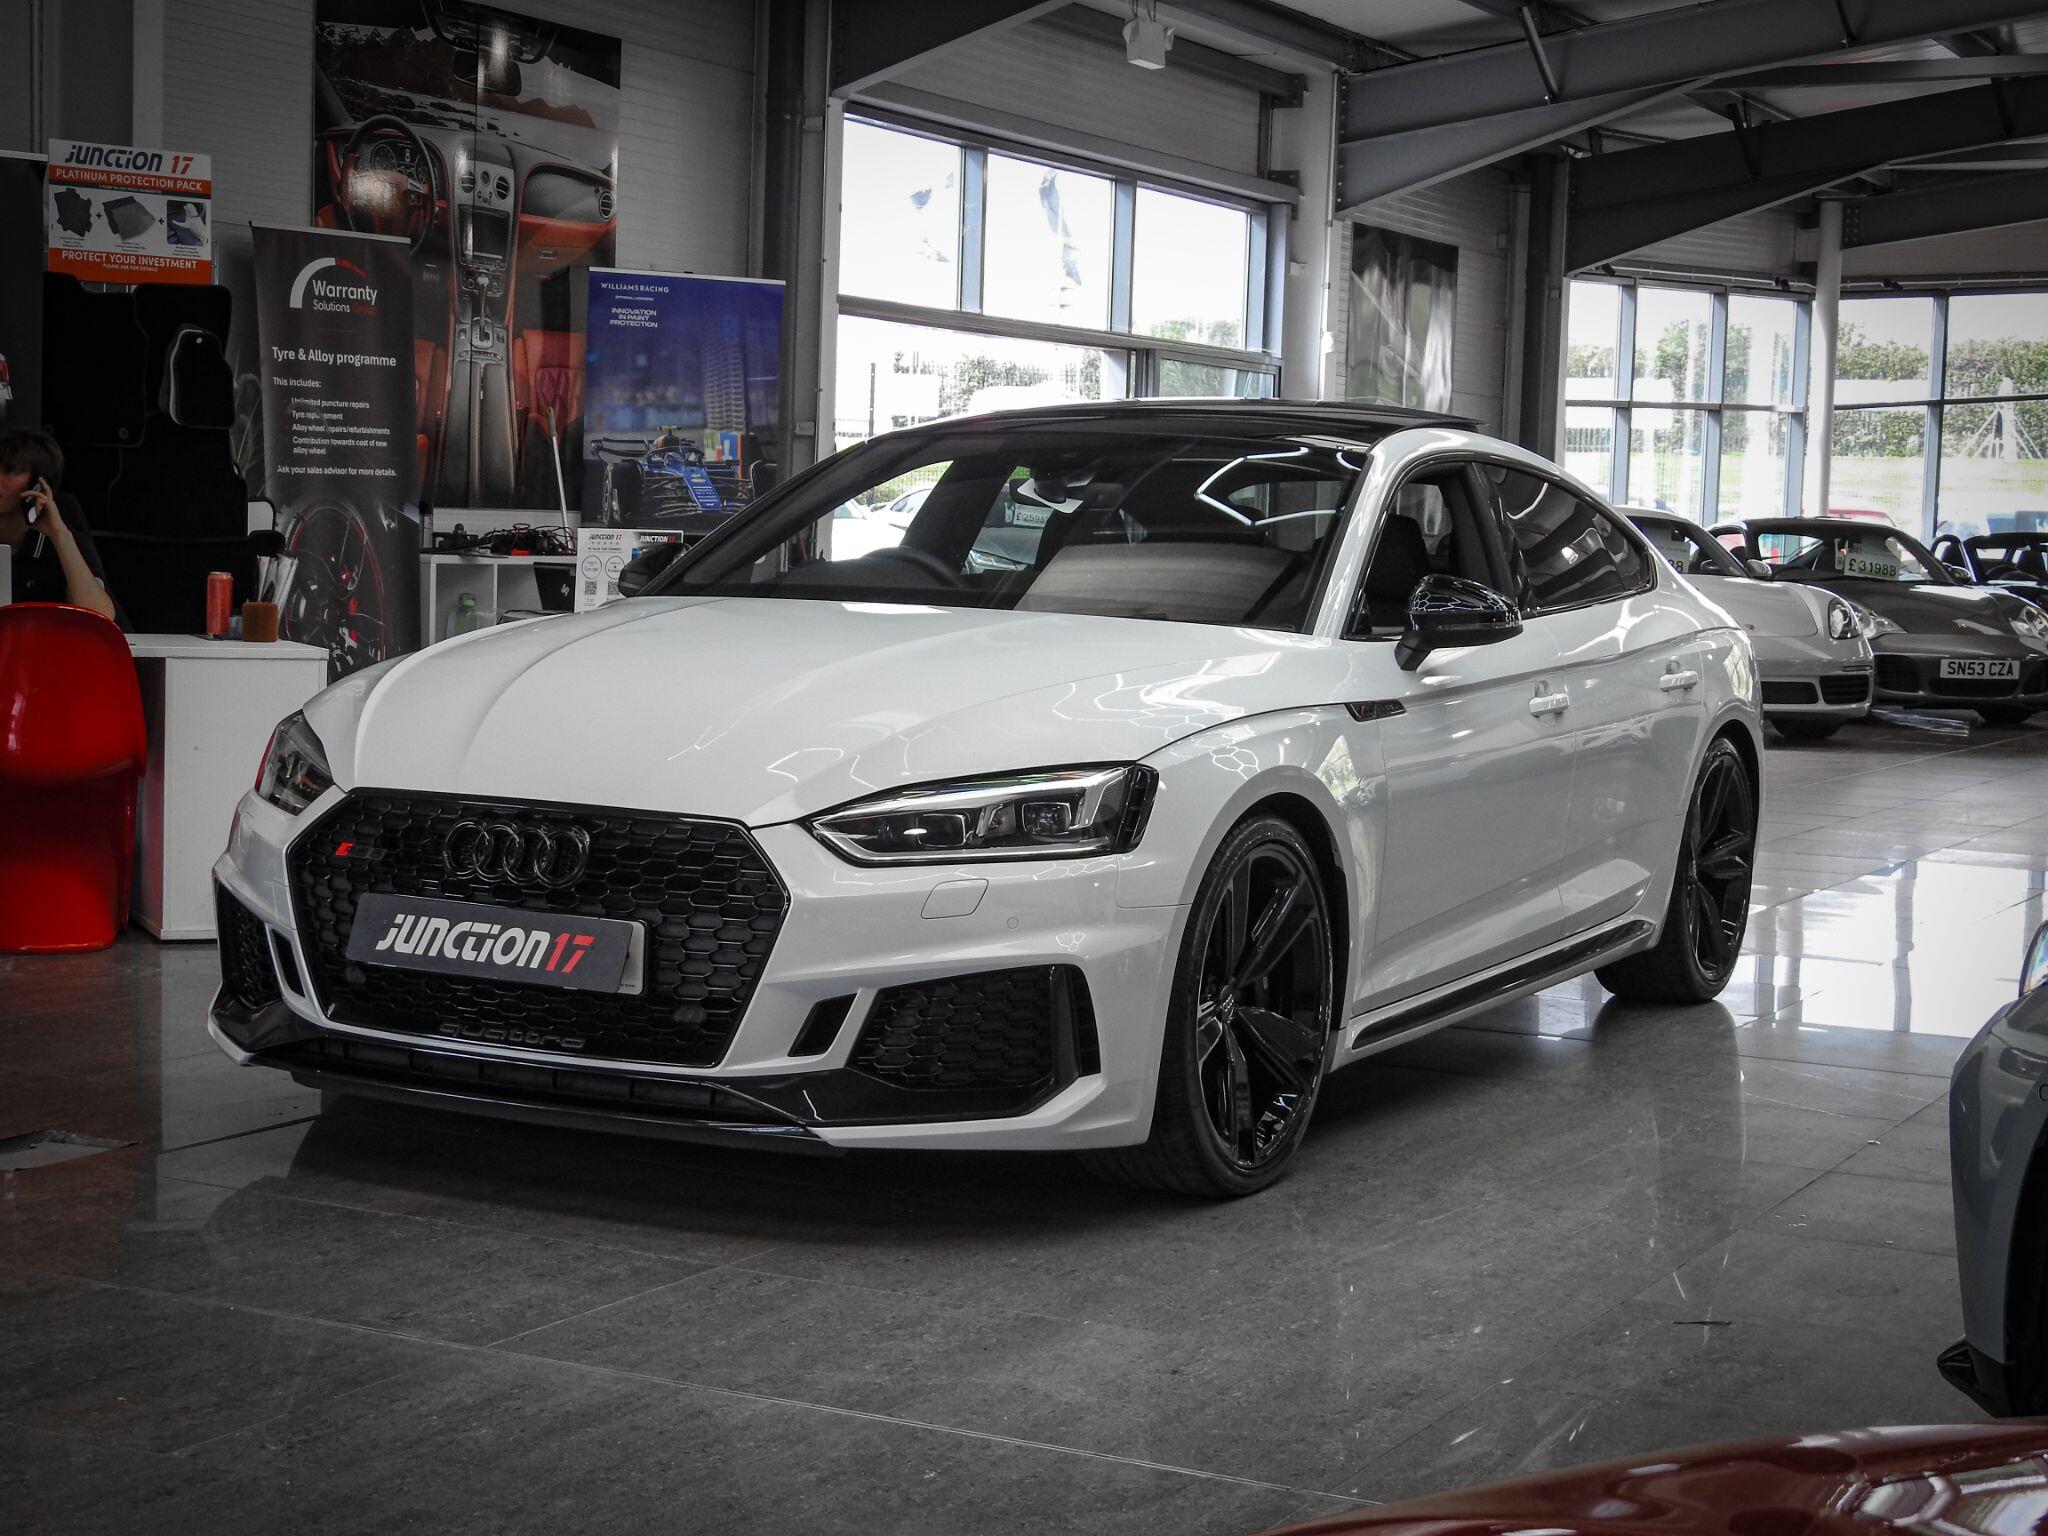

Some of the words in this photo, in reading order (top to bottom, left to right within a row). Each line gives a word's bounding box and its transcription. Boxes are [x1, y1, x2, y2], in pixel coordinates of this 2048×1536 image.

[65, 144, 164, 172] JUNCTION
[170, 155, 194, 175] 17
[56, 168, 107, 182] PLATINUM
[110, 173, 174, 188] PROTECTION
[176, 179, 203, 192] PACK
[62, 250, 108, 263] PROTECT
[109, 253, 136, 265] YOUR
[138, 256, 198, 270] INVESTMENT
[312, 279, 378, 306] Warranty
[600, 282, 639, 291] WILLIAMS
[640, 285, 670, 293] RACING
[313, 299, 351, 313] Solutions
[611, 307, 657, 316] INNOVATION
[609, 319, 658, 328] PROTECTION
[272, 346, 295, 362] Tyre
[298, 348, 306, 361] &
[308, 349, 335, 365] Alloy
[336, 353, 397, 367] programme
[273, 377, 288, 386] This
[289, 377, 322, 388] includes:
[321, 400, 349, 409] puncture
[292, 410, 305, 419] Tyre
[292, 423, 308, 433] Alloy
[308, 424, 325, 432] wheel
[292, 436, 330, 445] Contribution
[330, 438, 355, 446] towards
[369, 439, 375, 447] of
[293, 446, 308, 456] alloy
[308, 447, 326, 455] wheel
[277, 465, 290, 473] Ask
[290, 467, 306, 475] your
[306, 466, 323, 474] sales
[323, 467, 348, 475] advisor
[348, 467, 357, 475] for
[374, 468, 398, 476] details.
[1947, 661, 1985, 676] SN53
[1989, 662, 2014, 676] CZA
[438, 1021, 586, 1049] quattro
